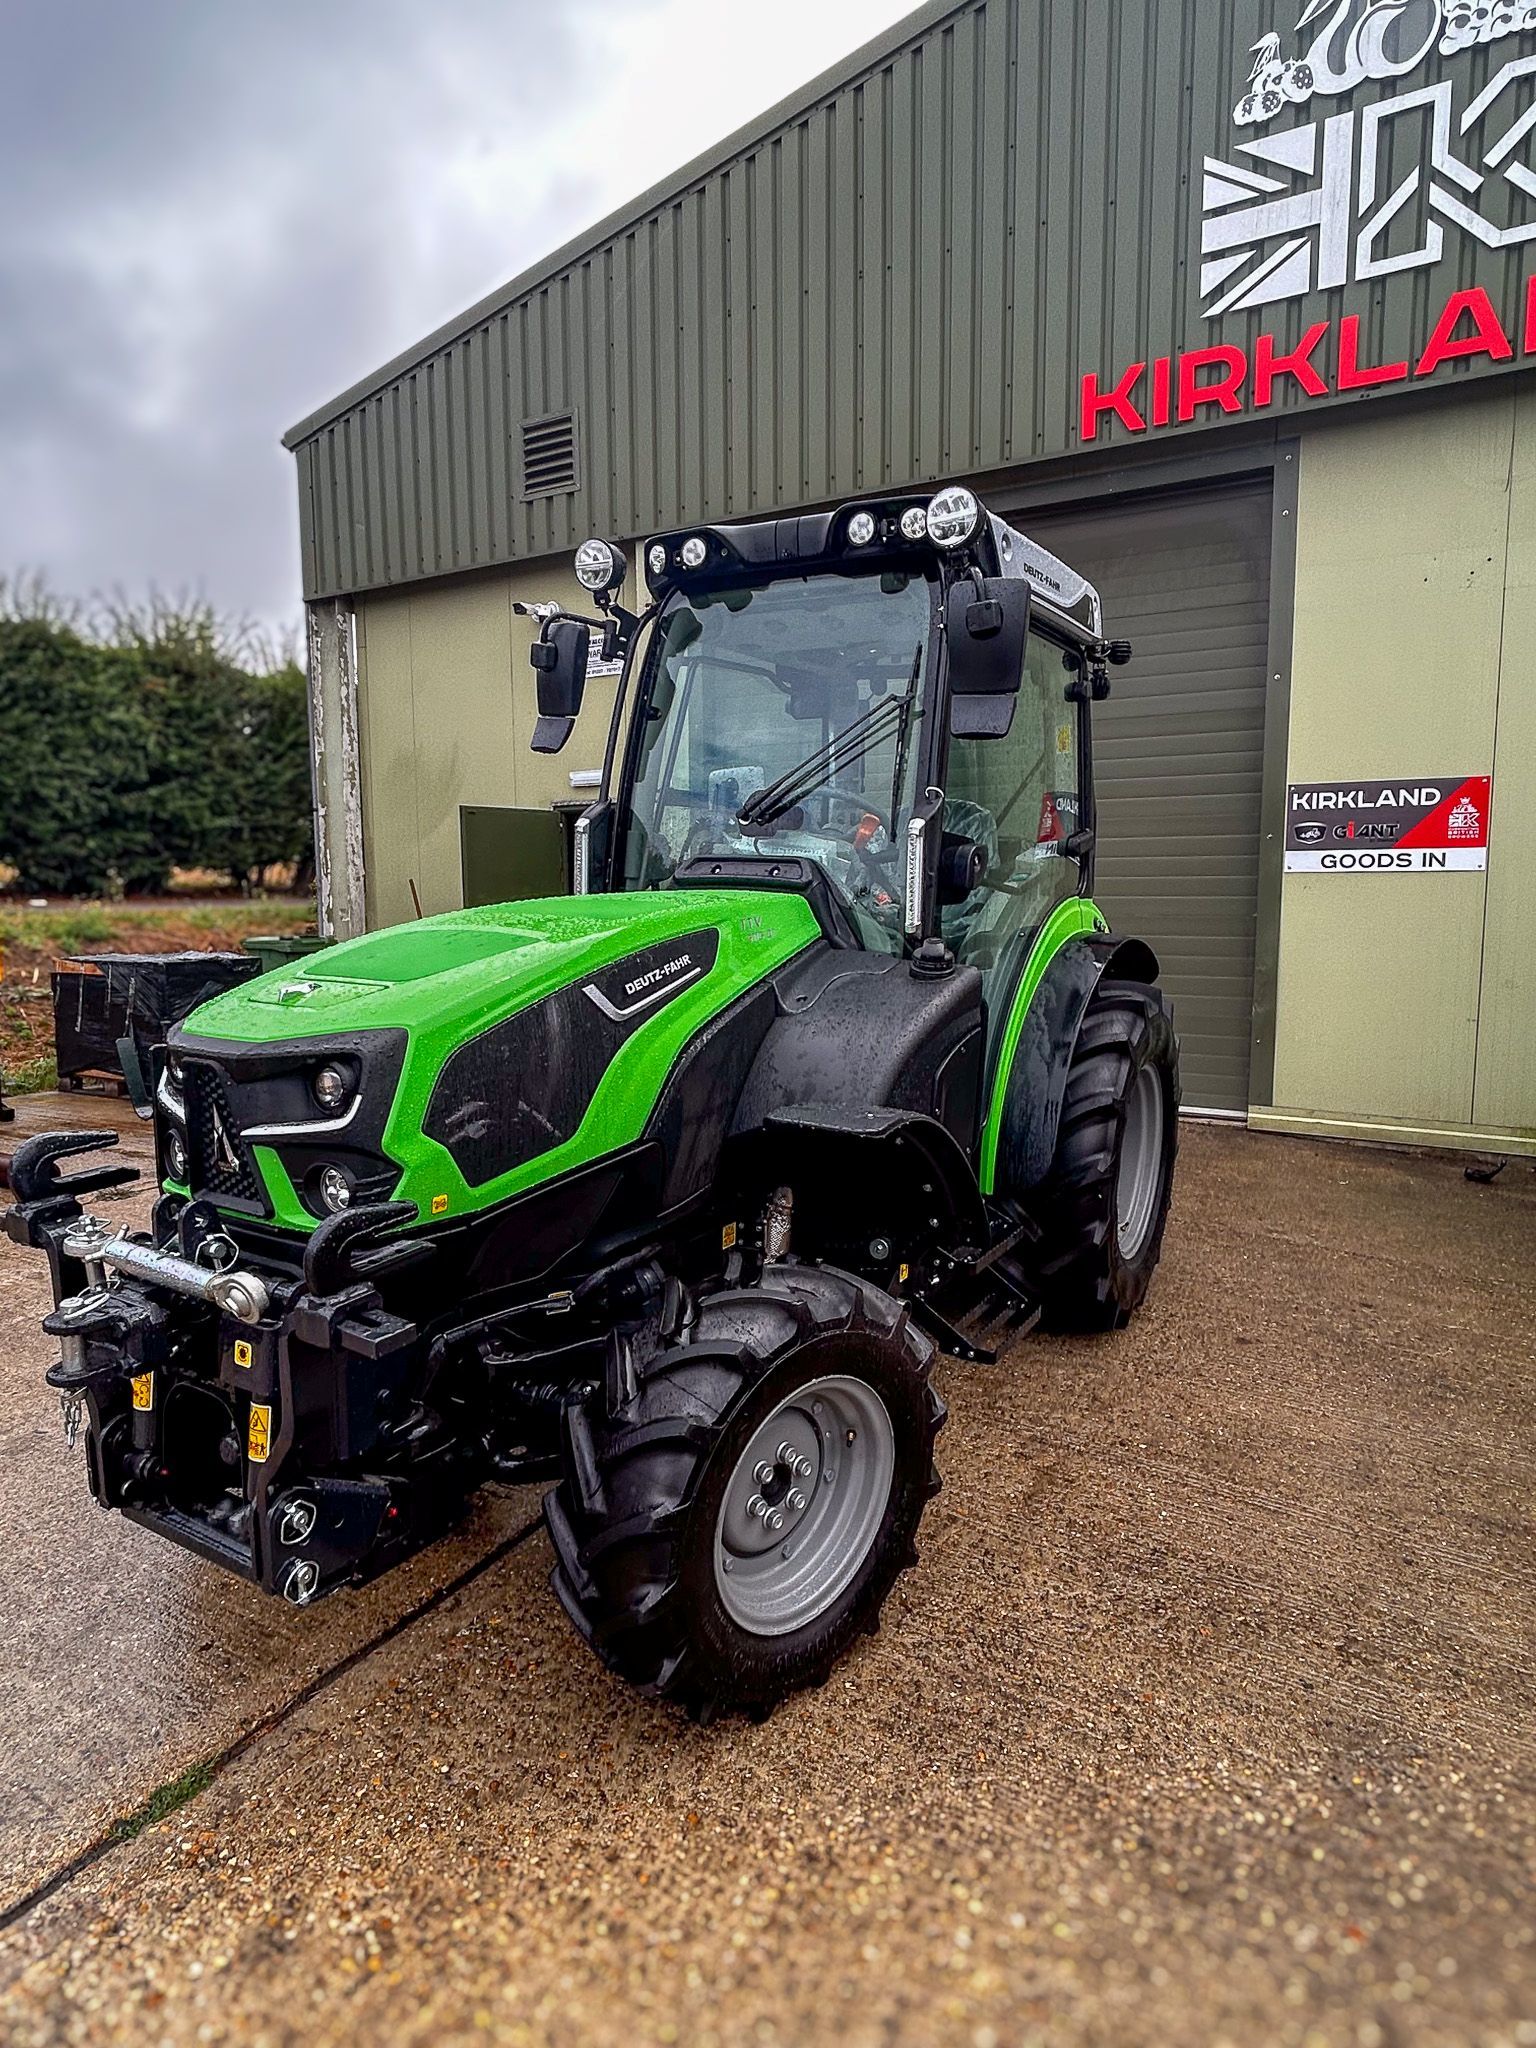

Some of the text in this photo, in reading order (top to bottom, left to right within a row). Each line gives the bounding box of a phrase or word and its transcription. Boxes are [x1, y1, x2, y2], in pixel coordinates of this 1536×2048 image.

[1081, 275, 1536, 441] KIRKLA
[1023, 562, 1061, 593] DEUTZ-FAHR
[1291, 787, 1442, 811] KIRKLAND
[1320, 852, 1447, 869] GOODS IN
[624, 953, 692, 996] DEUTZ-FAHR
